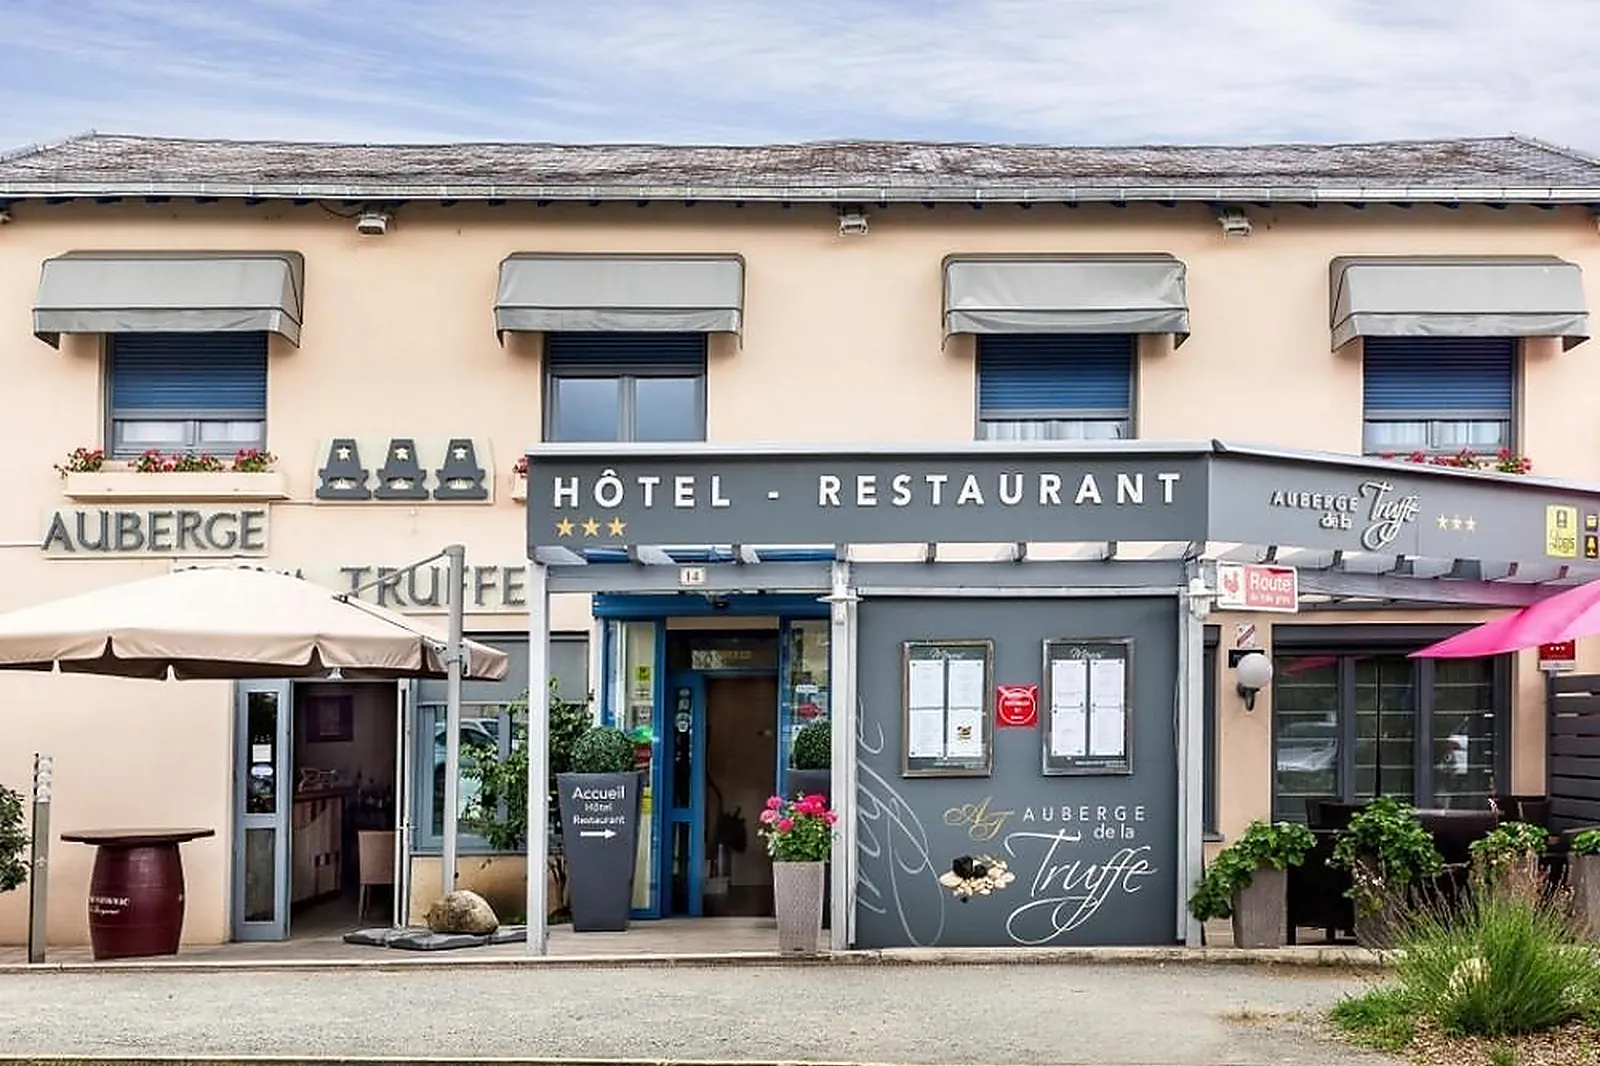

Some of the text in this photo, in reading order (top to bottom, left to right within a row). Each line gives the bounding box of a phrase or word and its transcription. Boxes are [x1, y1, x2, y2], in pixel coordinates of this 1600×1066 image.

[552, 470, 732, 509] HÔTEL
[819, 472, 1183, 507] RESTAURANT
[1271, 490, 1359, 512] AUBERGE
[42, 509, 265, 552] AUBERGE
[1250, 572, 1293, 591] Route
[572, 785, 626, 800] Accueil
[584, 803, 612, 812] Hôtel
[1022, 805, 1147, 823] AUBERGE
[573, 815, 626, 825] Restaurant
[1094, 824, 1135, 840] de la
[1005, 829, 1158, 945] Truffe
